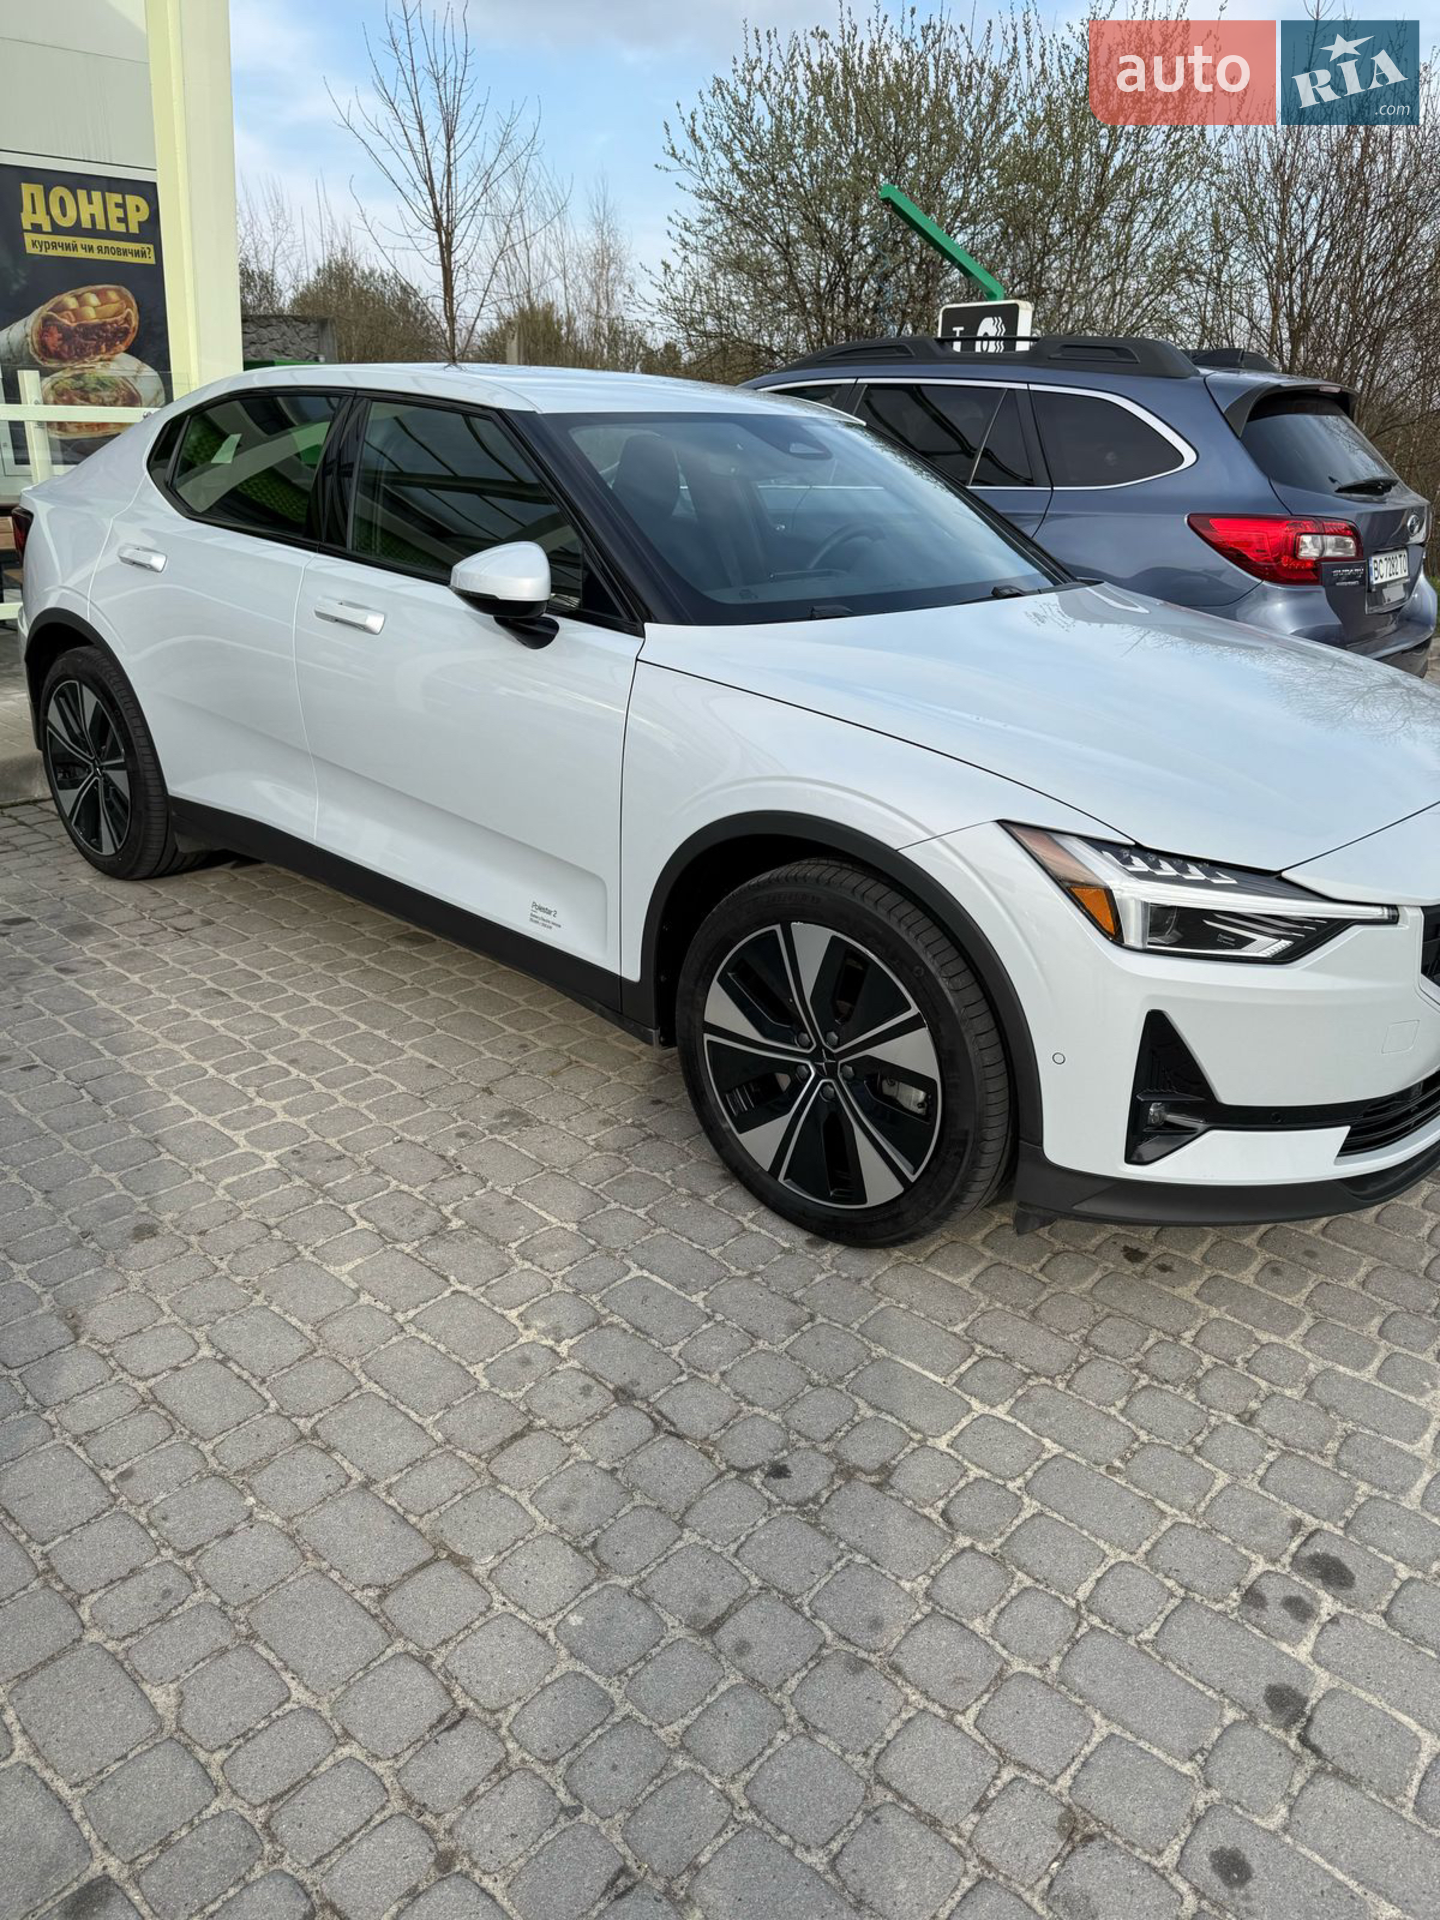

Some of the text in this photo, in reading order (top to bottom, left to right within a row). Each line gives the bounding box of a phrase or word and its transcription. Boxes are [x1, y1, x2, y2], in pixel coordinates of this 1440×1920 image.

[20, 182, 150, 234] ДОНЕР
[31, 238, 152, 259] курячий чи яловичий?
